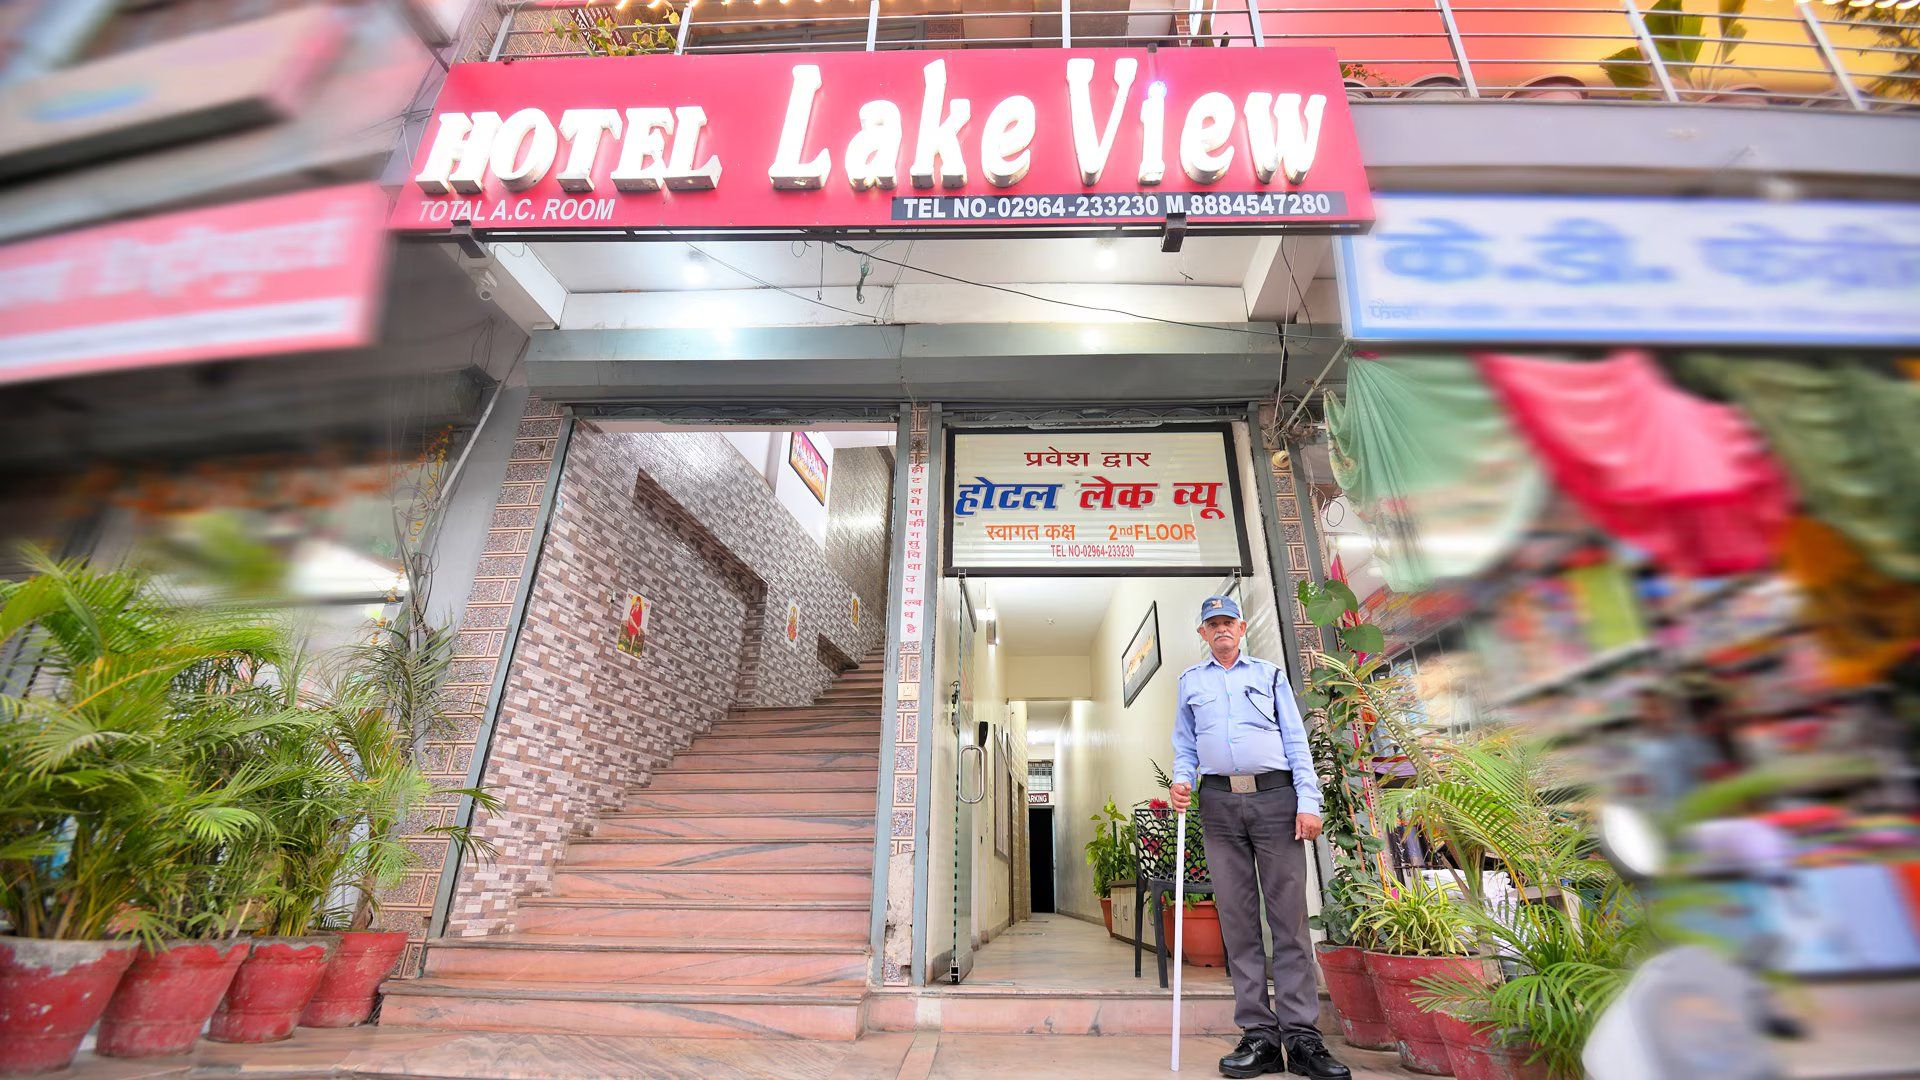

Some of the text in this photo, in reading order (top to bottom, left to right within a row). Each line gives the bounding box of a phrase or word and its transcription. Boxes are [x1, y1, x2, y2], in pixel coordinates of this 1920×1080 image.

[415, 58, 1327, 194] HOTEL Lake View
[419, 198, 616, 221] TOTAL A.C. ROOM
[904, 198, 945, 218] TEL
[1024, 446, 1151, 468] प्रवेश द्वार
[954, 476, 1225, 519] होटल लेक व्यू
[985, 524, 1039, 541] स्वागत
[1045, 523, 1075, 540] कक्ष
[1050, 545, 1066, 557] TEL
[1028, 794, 1047, 803] ARKING
